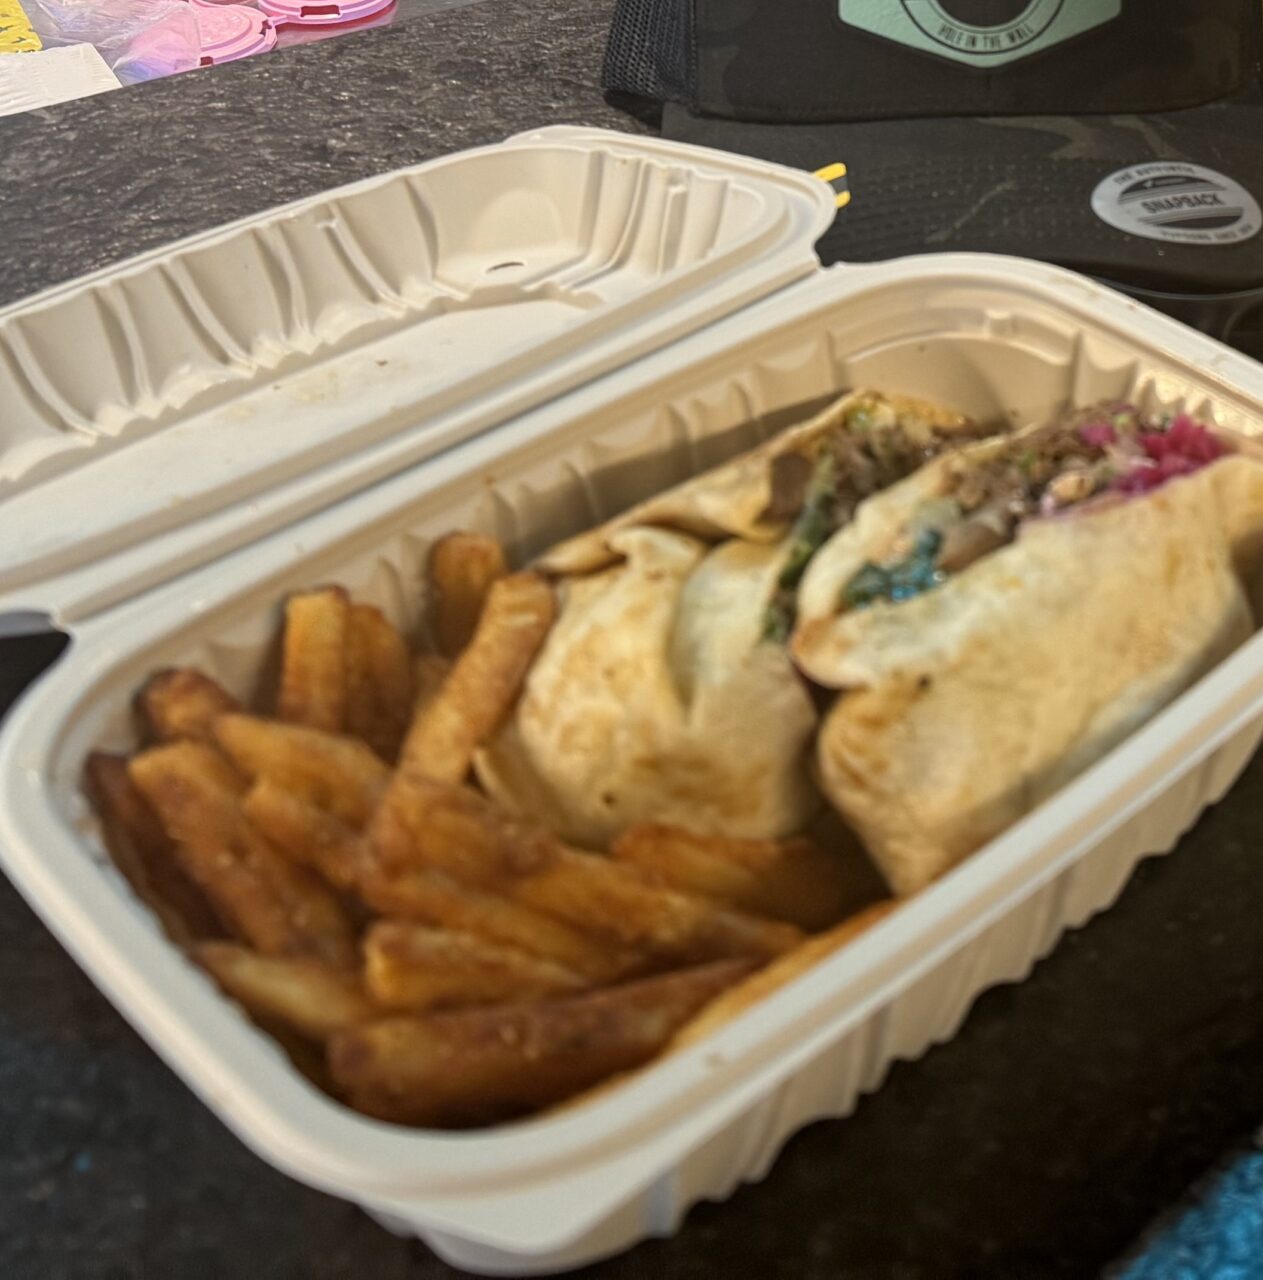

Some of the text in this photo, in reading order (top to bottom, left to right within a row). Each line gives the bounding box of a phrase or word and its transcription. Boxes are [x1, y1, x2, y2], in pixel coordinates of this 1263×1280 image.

[937, 23, 1035, 48] HOLE IN THE WALL
[1141, 193, 1224, 215] SNAPBACK
